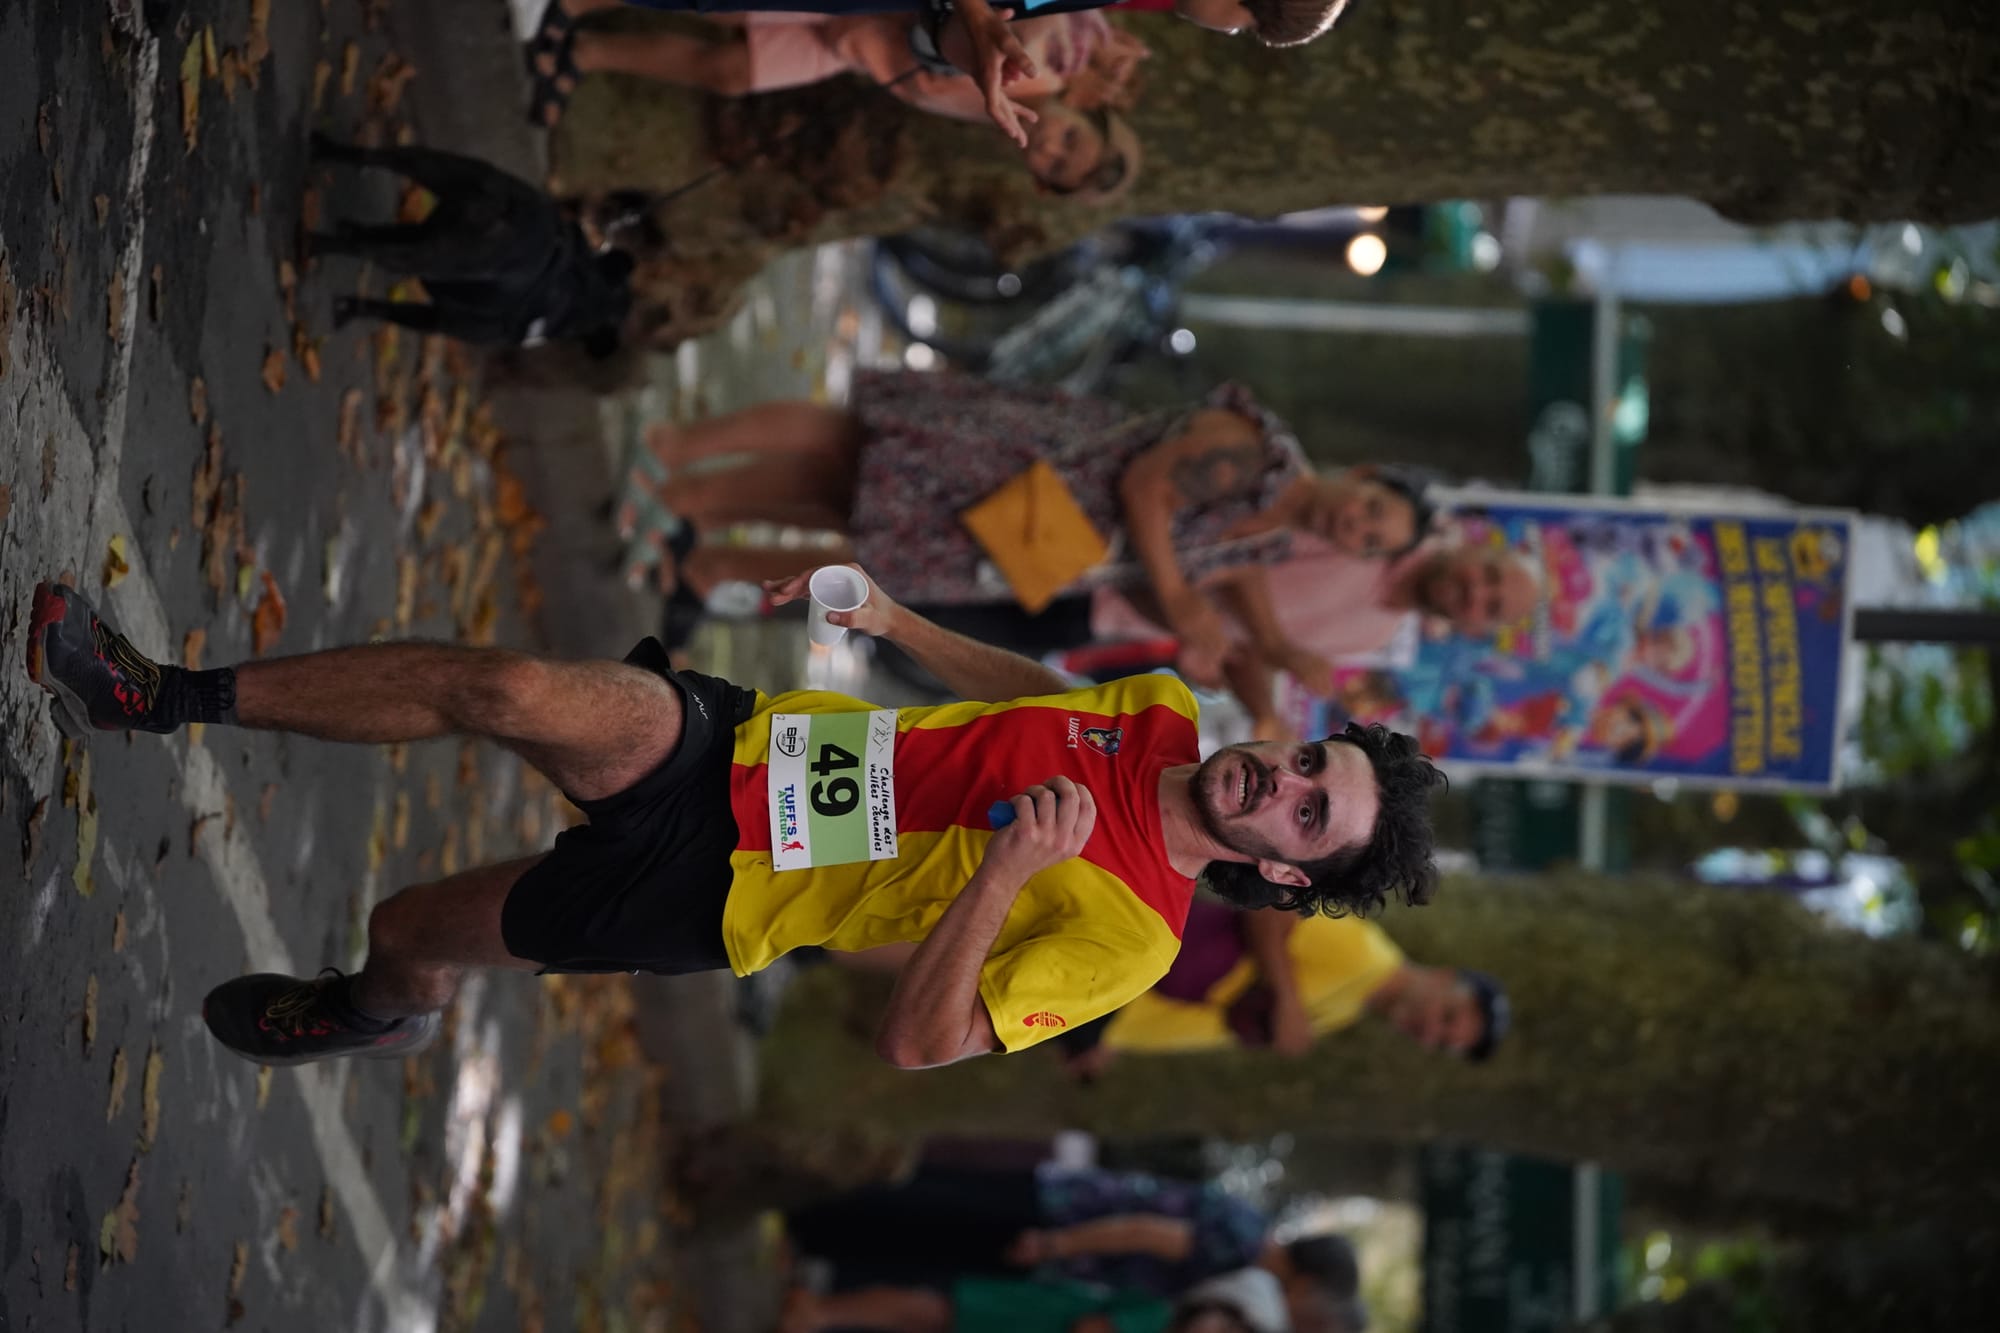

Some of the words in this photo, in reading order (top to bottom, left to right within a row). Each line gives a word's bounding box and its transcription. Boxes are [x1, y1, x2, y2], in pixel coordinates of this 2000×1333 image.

[786, 726, 798, 754] BFP
[810, 743, 861, 817] 49
[869, 763, 880, 799] vallées
[879, 767, 893, 822] Challenge
[777, 789, 789, 842] Aventure
[783, 783, 798, 836] TUFF'S
[870, 805, 883, 852] cévenoles
[882, 826, 893, 846] des
